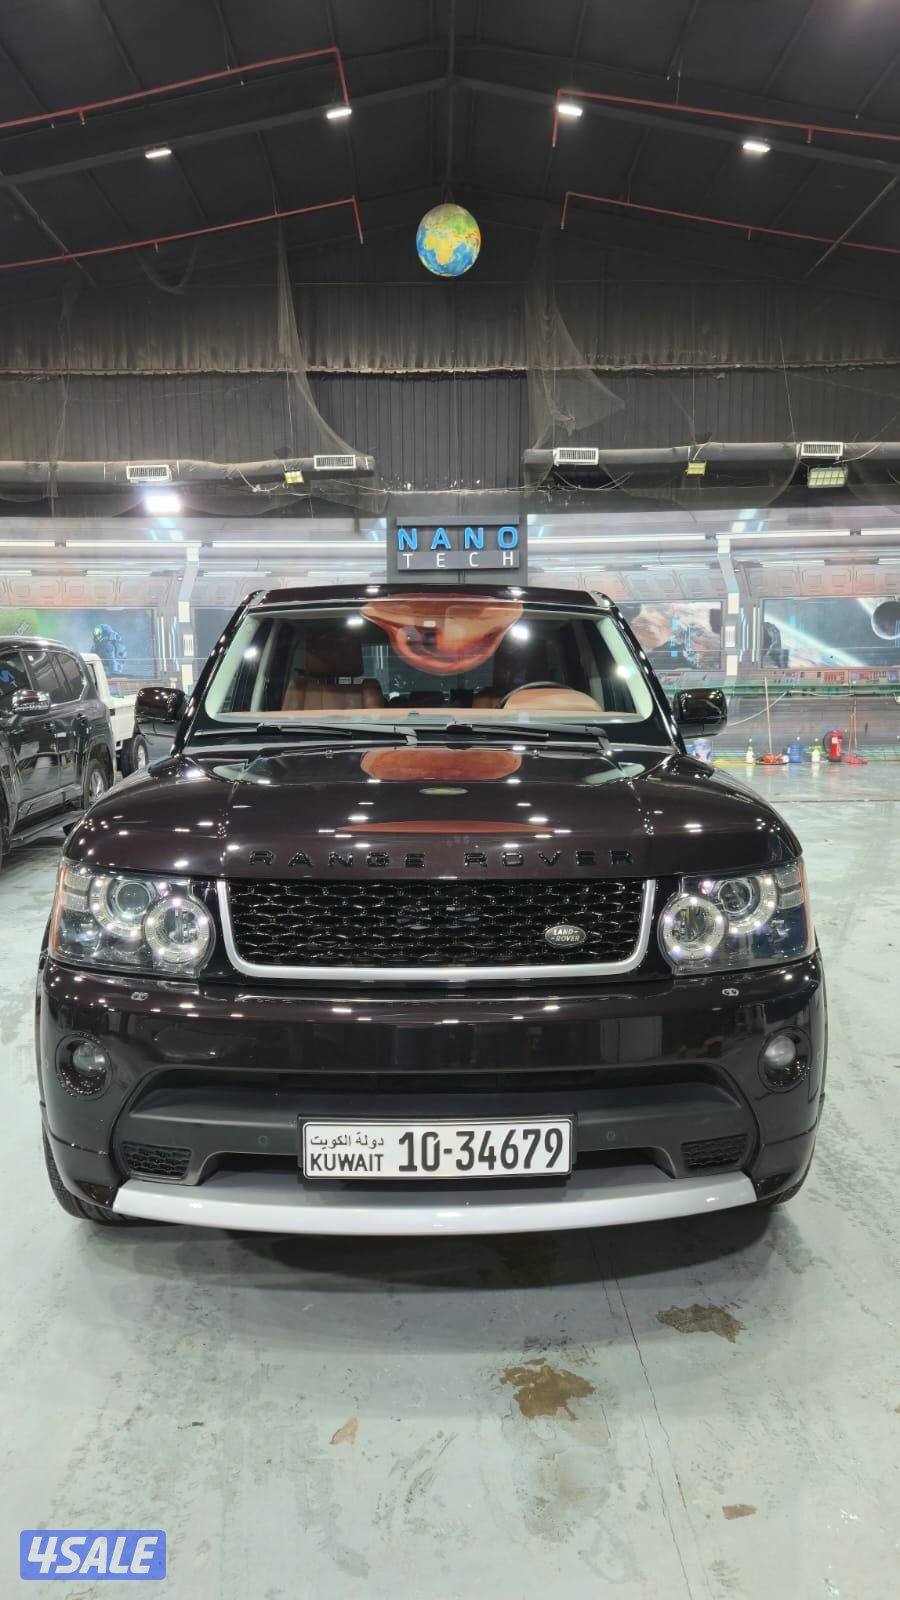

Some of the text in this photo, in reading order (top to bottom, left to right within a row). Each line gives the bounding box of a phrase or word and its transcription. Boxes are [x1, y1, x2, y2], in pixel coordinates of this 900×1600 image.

[397, 526, 519, 551] NANO
[402, 551, 514, 569] TECH
[249, 849, 634, 868] RANGE ROVER
[310, 1133, 352, 1150] الكويت
[398, 1128, 563, 1172] 10-34679
[310, 1153, 384, 1172] KUWAIT
